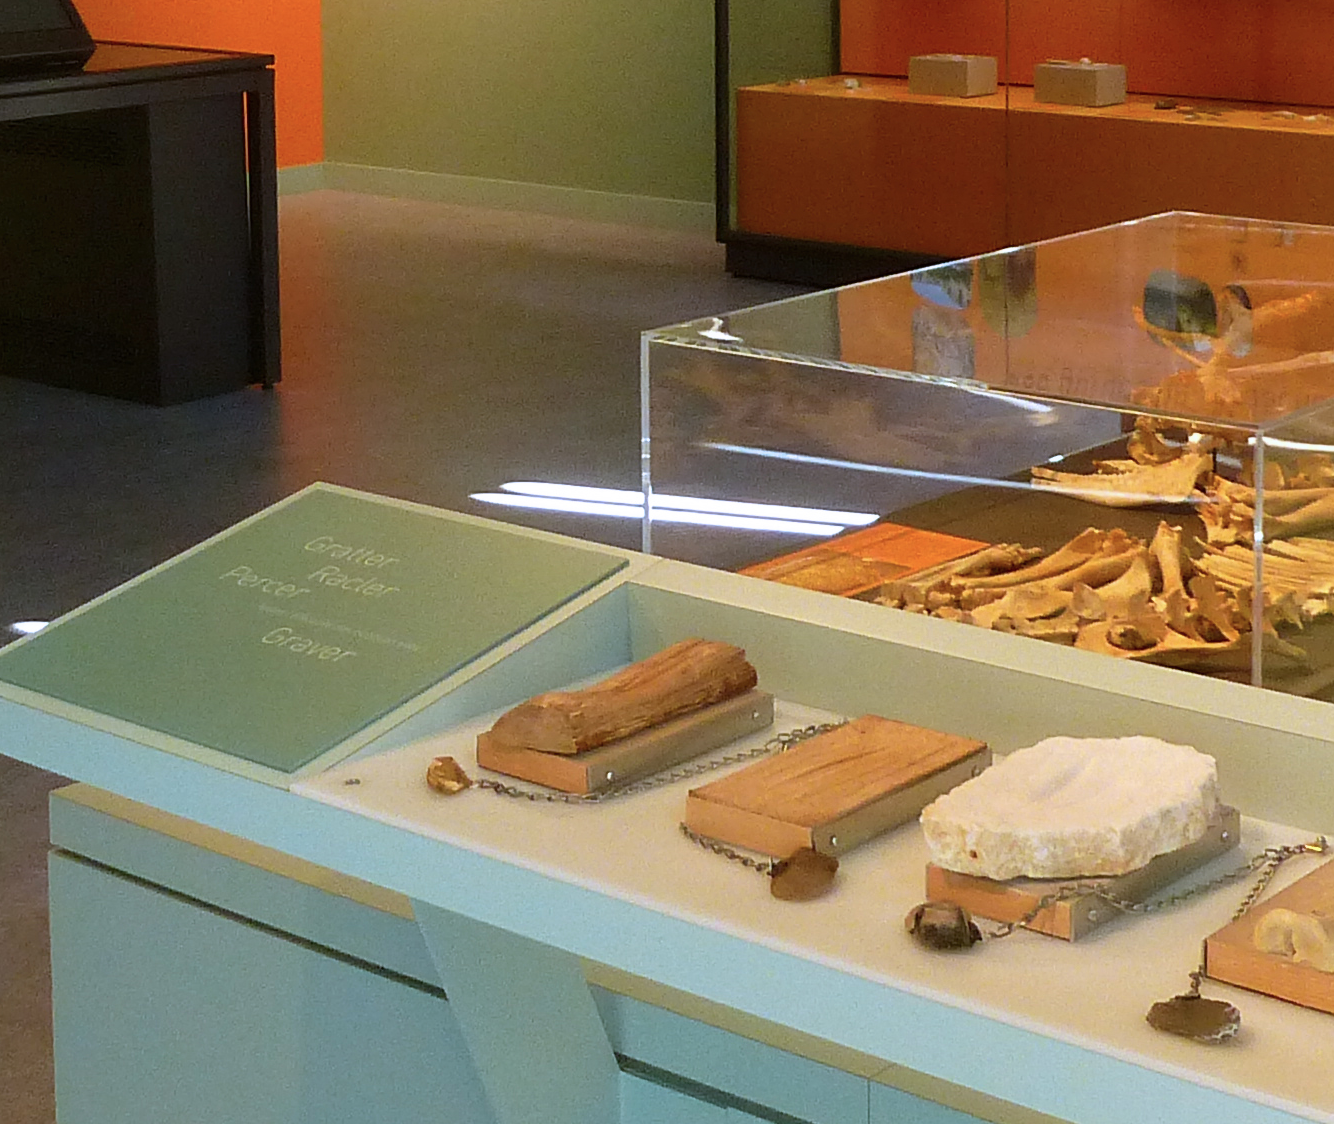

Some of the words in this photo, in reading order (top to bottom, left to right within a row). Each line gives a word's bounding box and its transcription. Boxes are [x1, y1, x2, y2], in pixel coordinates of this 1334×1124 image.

[303, 535, 401, 570] Gratter
[218, 564, 312, 599] Percer
[307, 564, 401, 599] Racler
[261, 626, 359, 663] Graver
